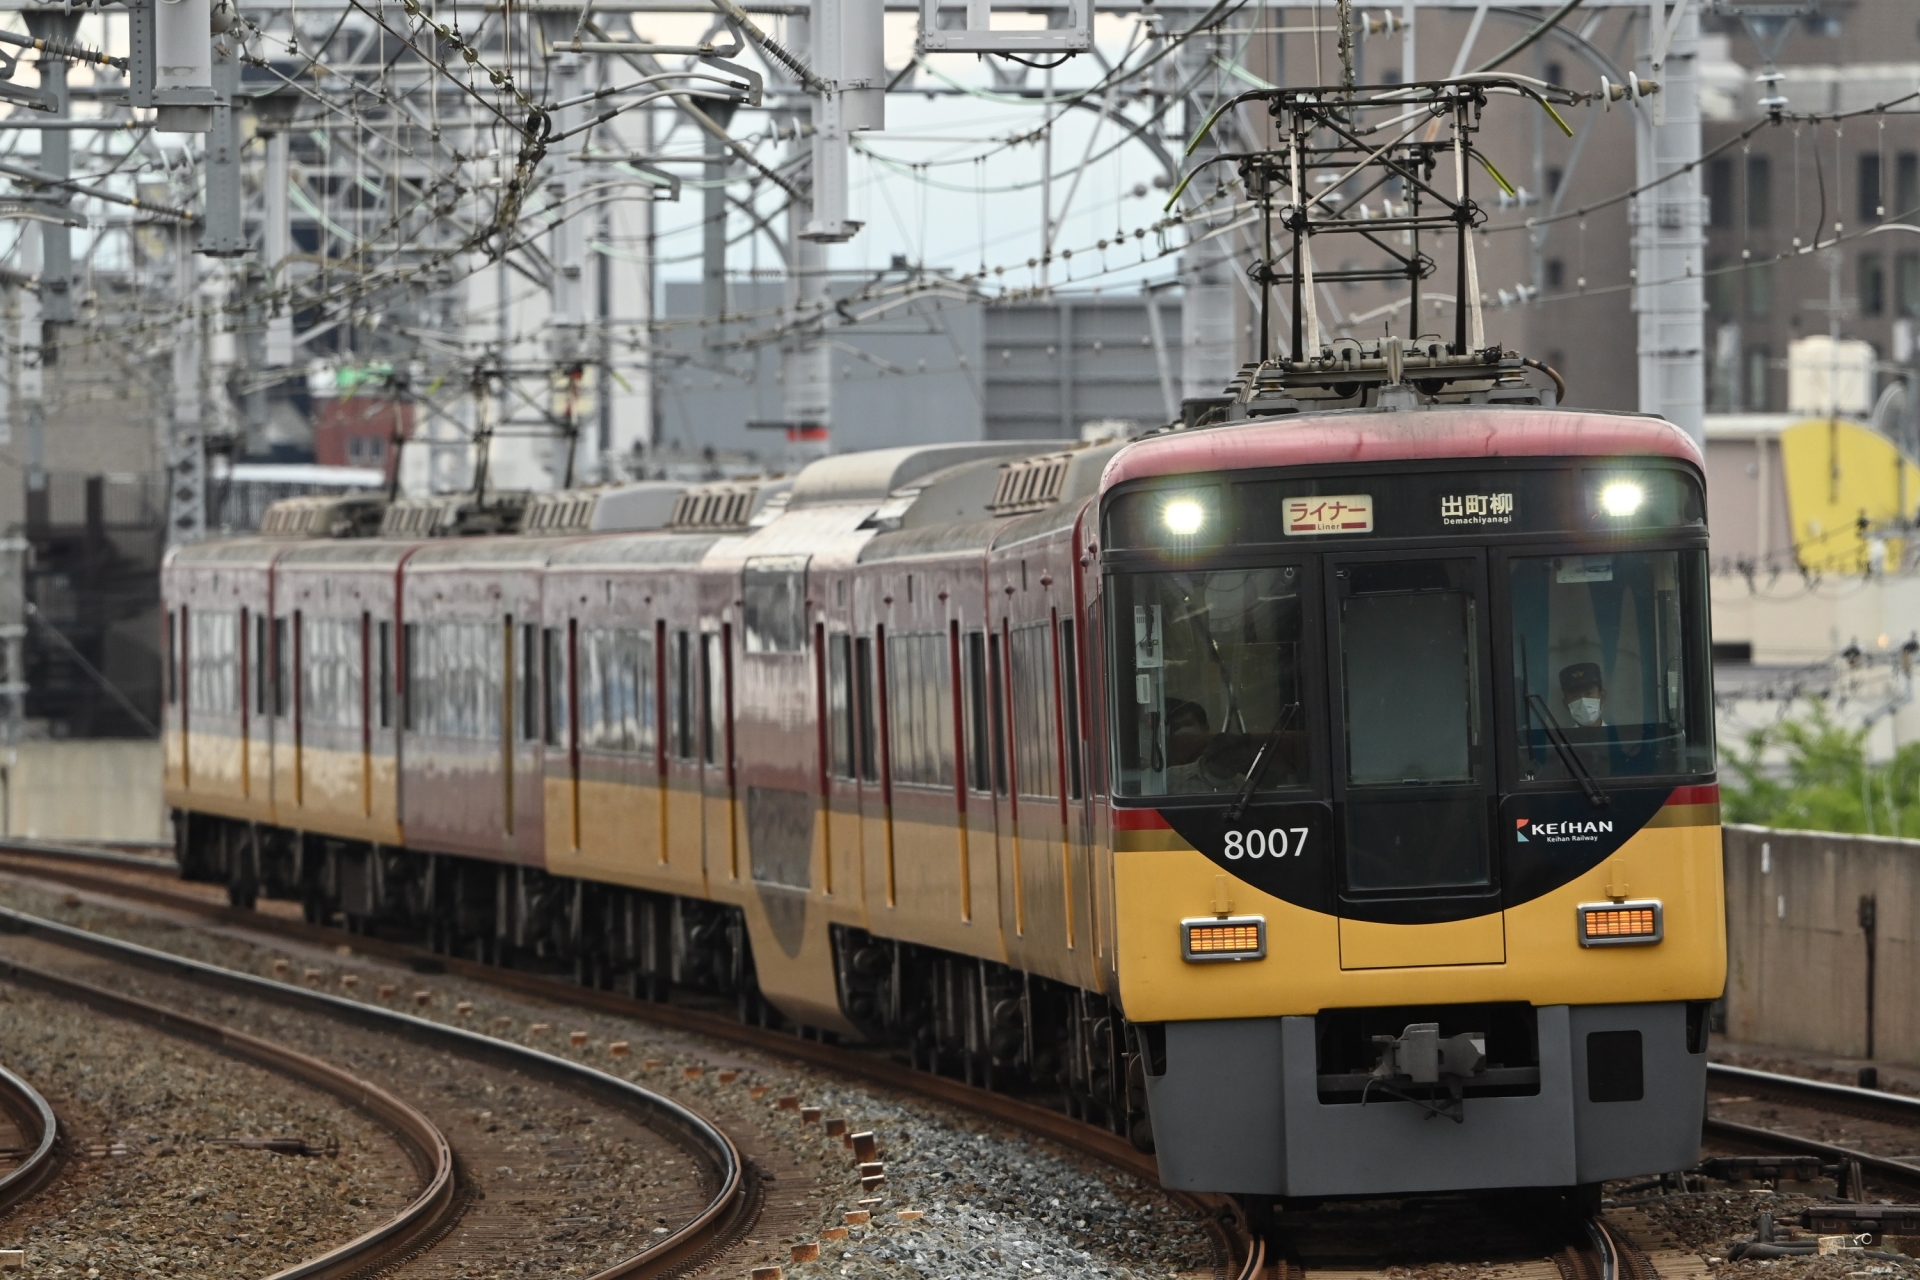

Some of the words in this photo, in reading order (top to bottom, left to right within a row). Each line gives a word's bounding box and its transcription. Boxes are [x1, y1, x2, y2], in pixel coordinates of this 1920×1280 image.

[1290, 501, 1366, 522] ライナー
[1441, 493, 1513, 517] 出町柳
[1317, 523, 1340, 531] Liner
[1443, 514, 1512, 525] Demachiyanagi
[1531, 820, 1613, 836] KEIHAN
[1223, 827, 1309, 860] 8007
[1571, 834, 1598, 842] Railway
